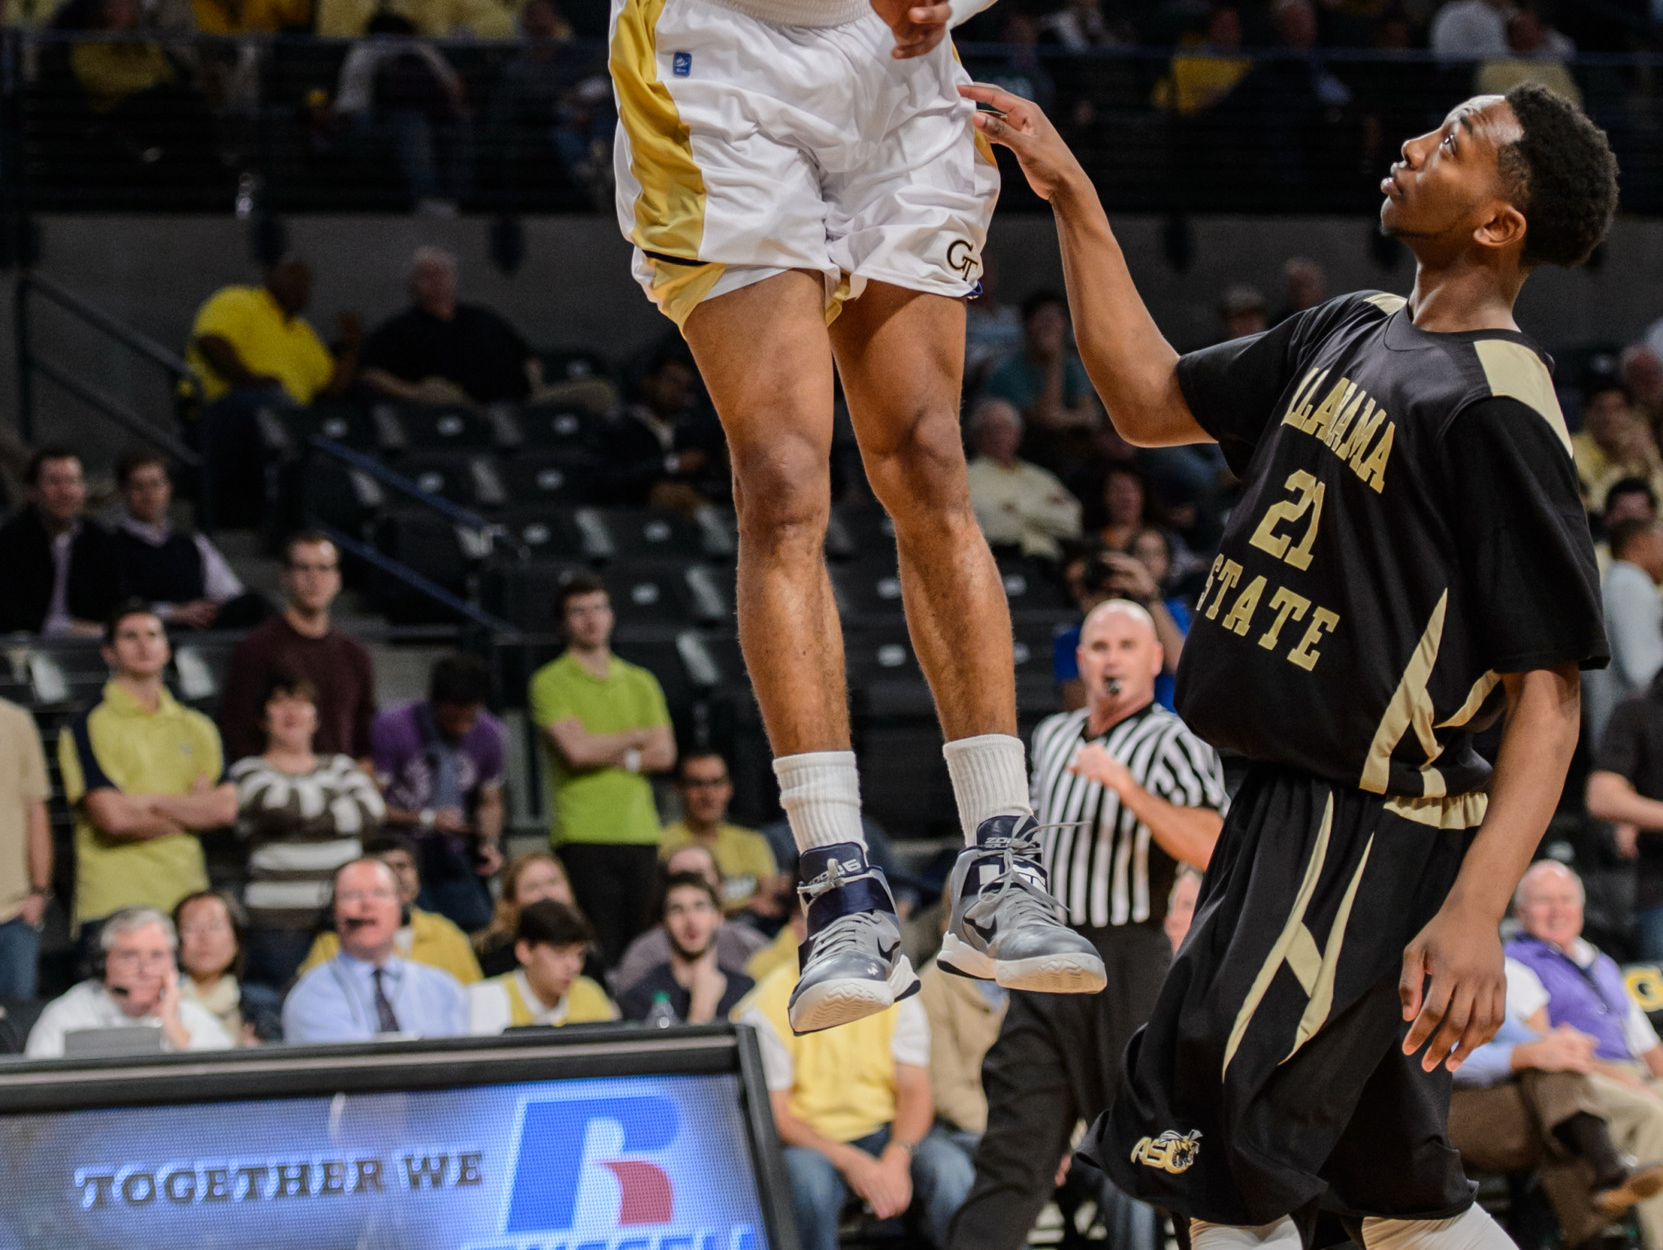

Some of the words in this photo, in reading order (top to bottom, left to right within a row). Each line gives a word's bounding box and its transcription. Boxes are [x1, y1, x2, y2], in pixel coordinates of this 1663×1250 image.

[1249, 468, 1326, 572] 21
[1196, 553, 1341, 672] STATE
[76, 1155, 383, 1209] TOGETHER
[398, 1148, 483, 1188] WE
